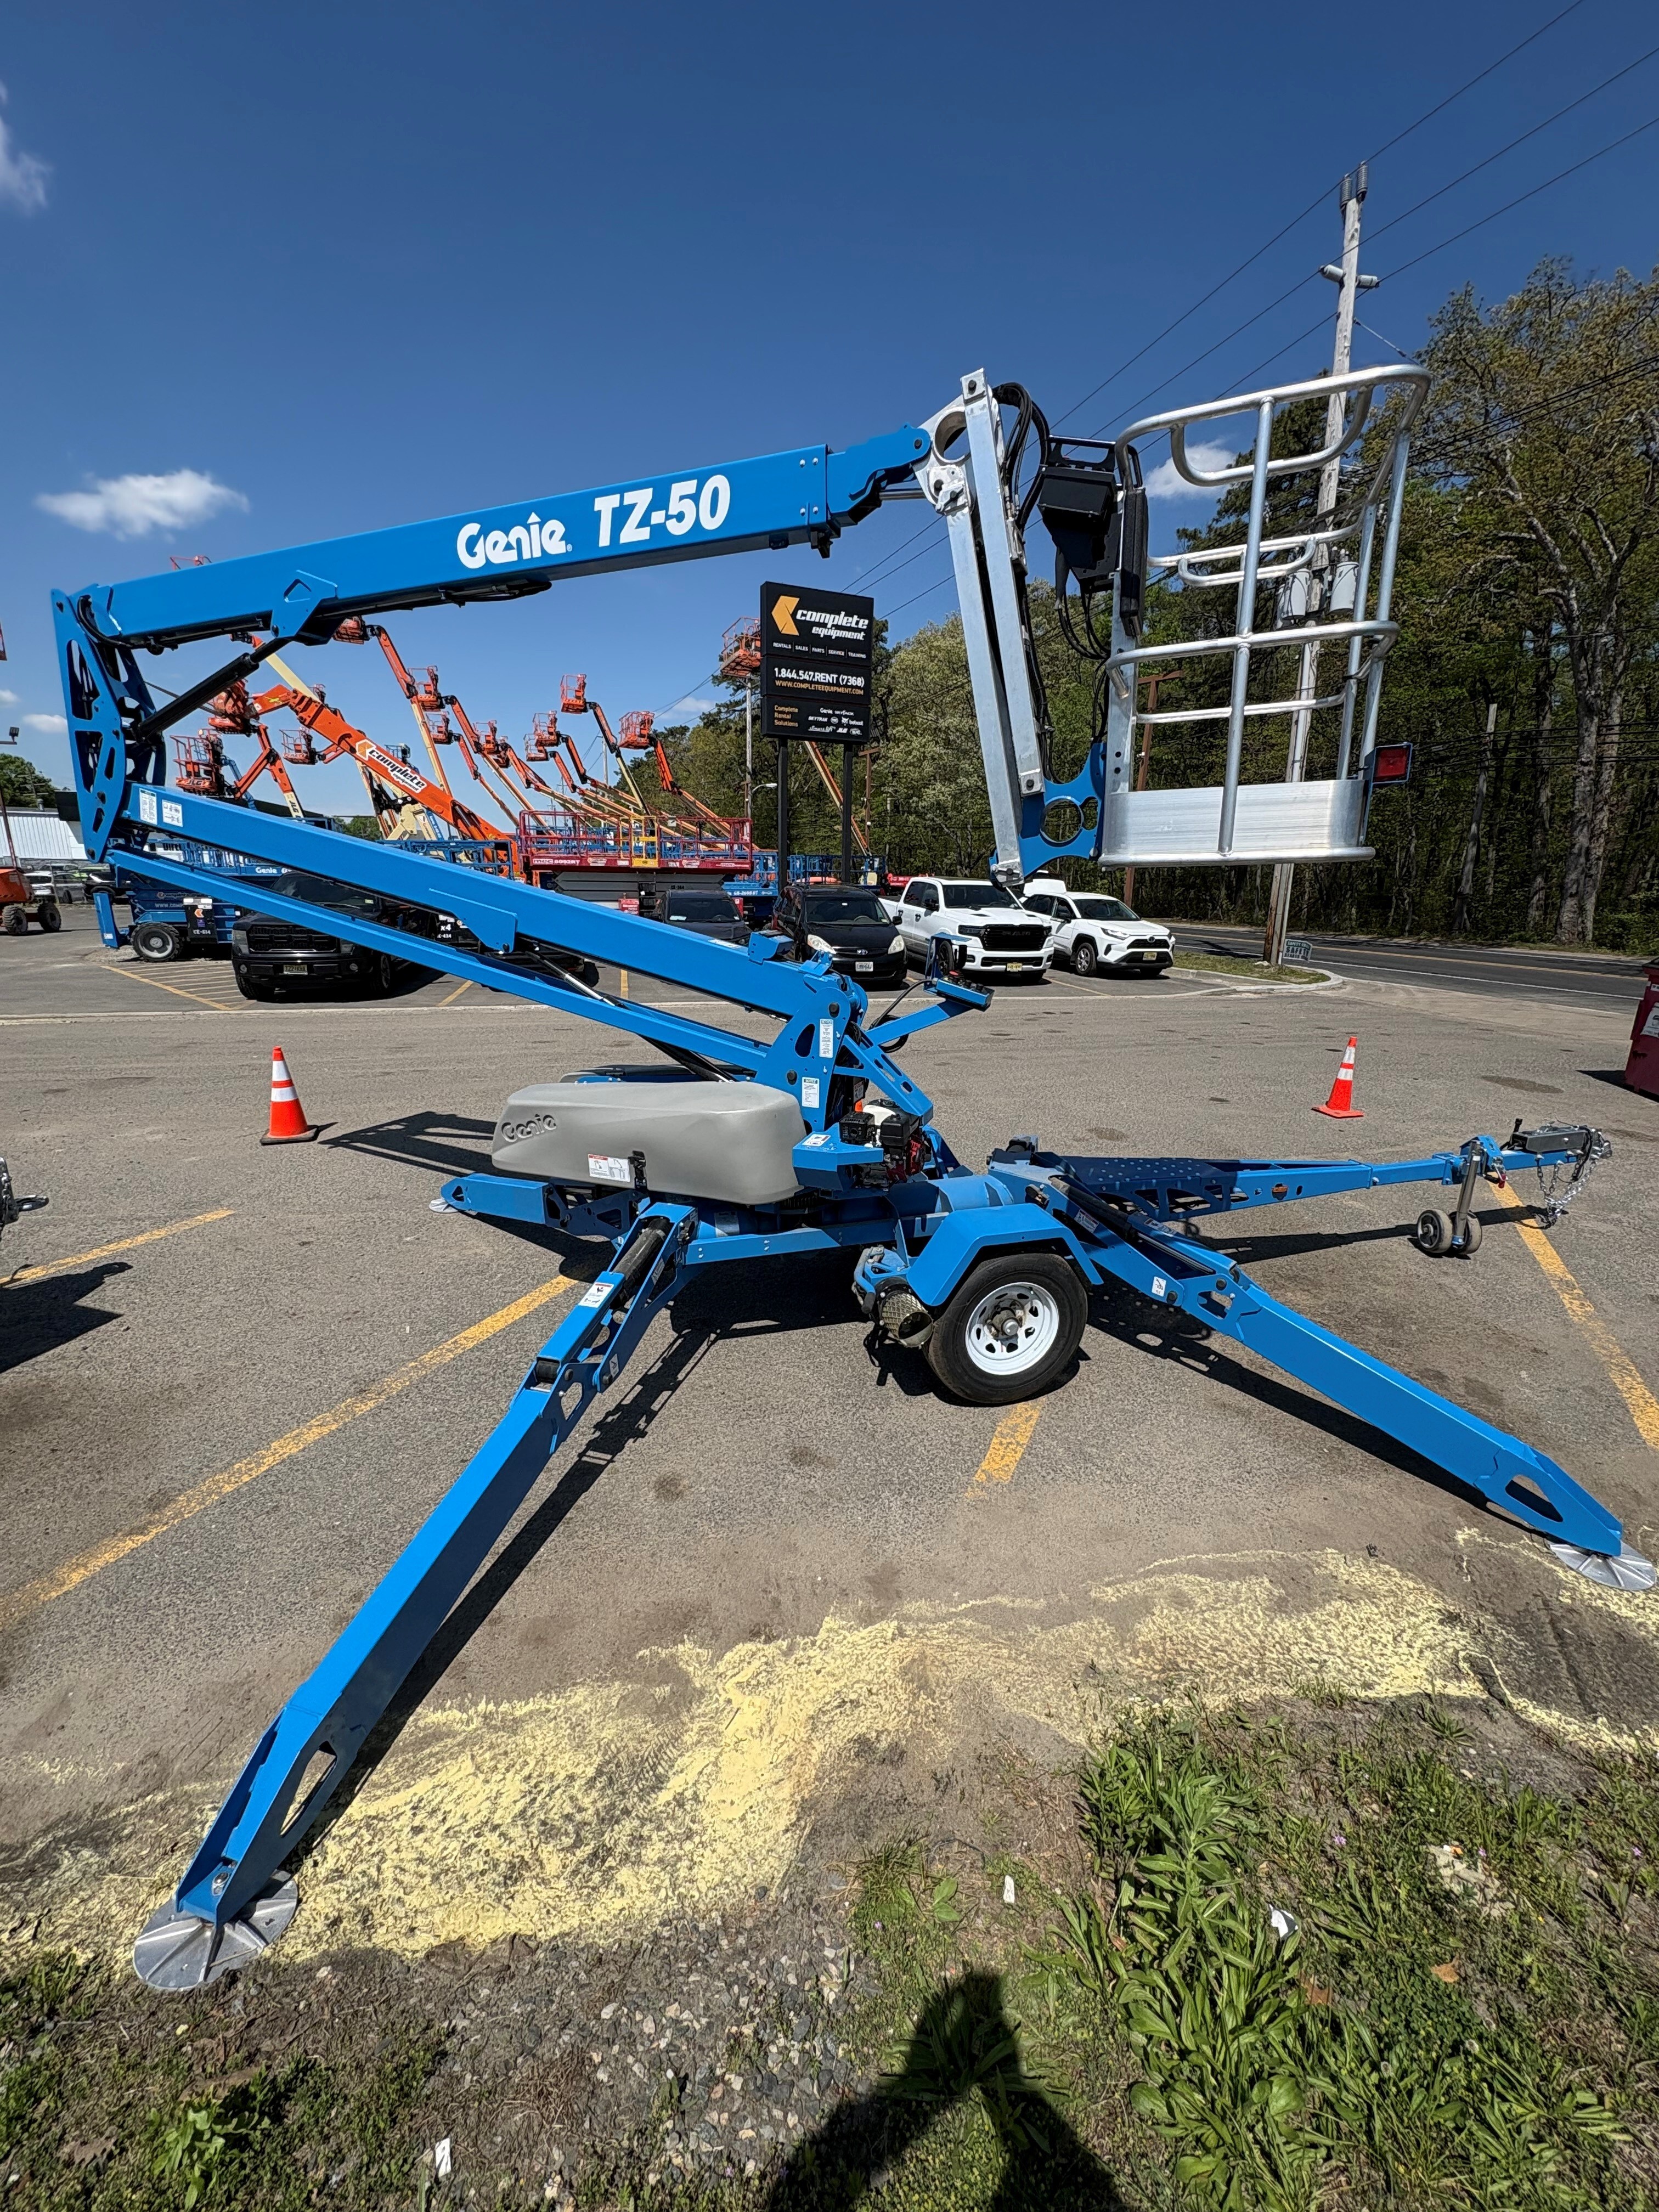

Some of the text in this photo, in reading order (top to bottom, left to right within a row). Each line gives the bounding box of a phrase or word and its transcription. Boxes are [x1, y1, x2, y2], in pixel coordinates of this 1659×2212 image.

[456, 475, 730, 569] Genie TZ-50
[796, 610, 868, 629] complete
[811, 627, 866, 640] equipment
[774, 667, 865, 687] 1.844.547.RENT (7368)
[775, 680, 864, 695] WWW.COMPLETEEQUIPMENT.COM
[774, 704, 798, 713] Complete
[368, 749, 425, 789] complete
[392, 772, 419, 792] equipment
[501, 1114, 557, 1143] Genie
